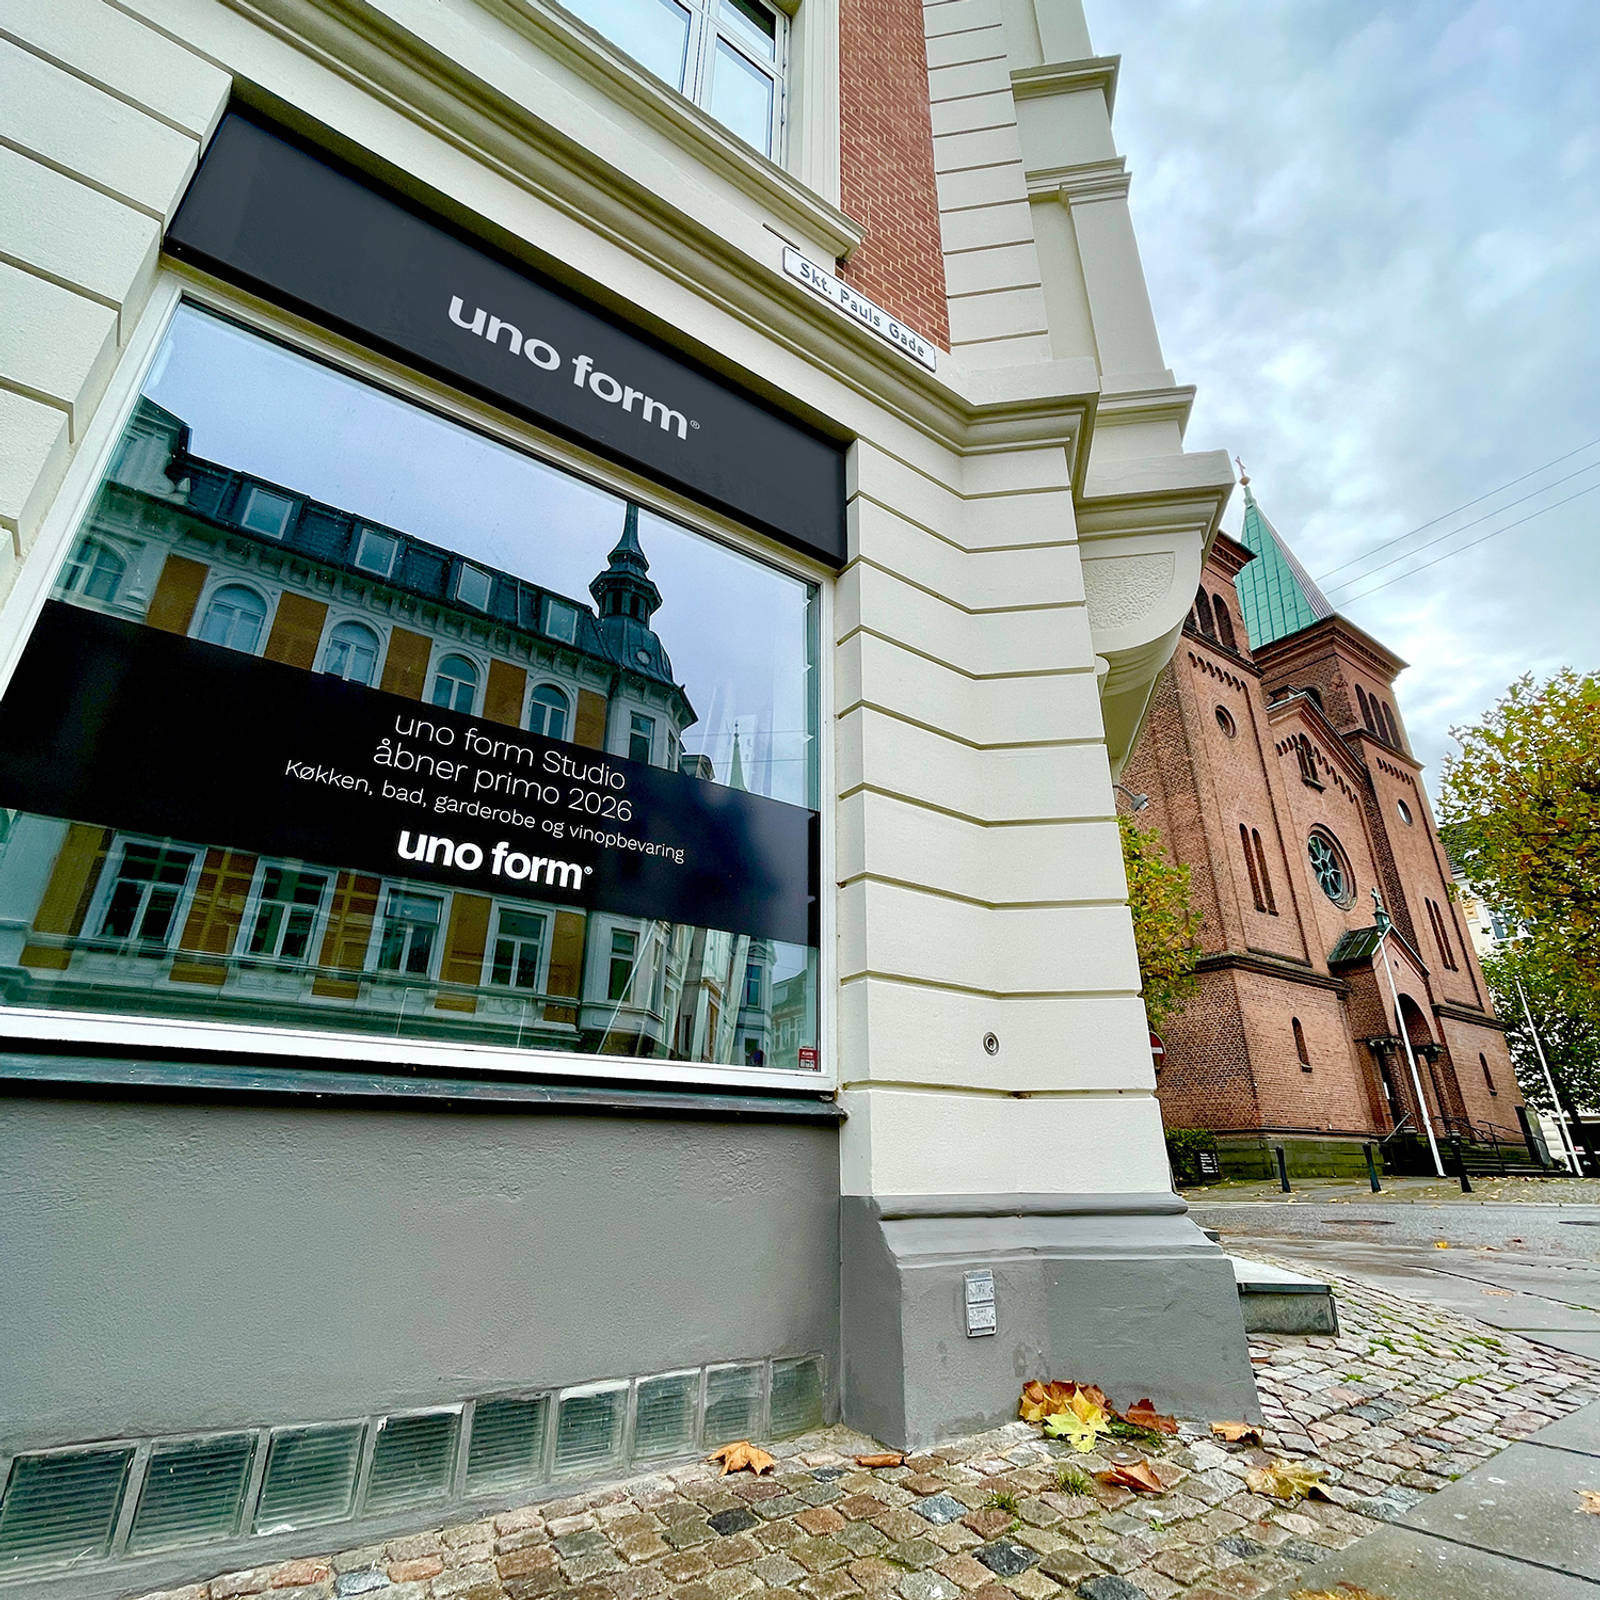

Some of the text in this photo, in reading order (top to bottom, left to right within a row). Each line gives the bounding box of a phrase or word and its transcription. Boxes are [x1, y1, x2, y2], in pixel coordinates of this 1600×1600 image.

[449, 296, 561, 371] uno
[799, 262, 925, 358] Skt. Pauls Gade
[373, 737, 633, 822] åbner primo 2026
[394, 714, 626, 790] uno form Studio
[285, 759, 686, 865] Køkken, bad, garderobe og vinopbevaring
[397, 830, 484, 871] uno
